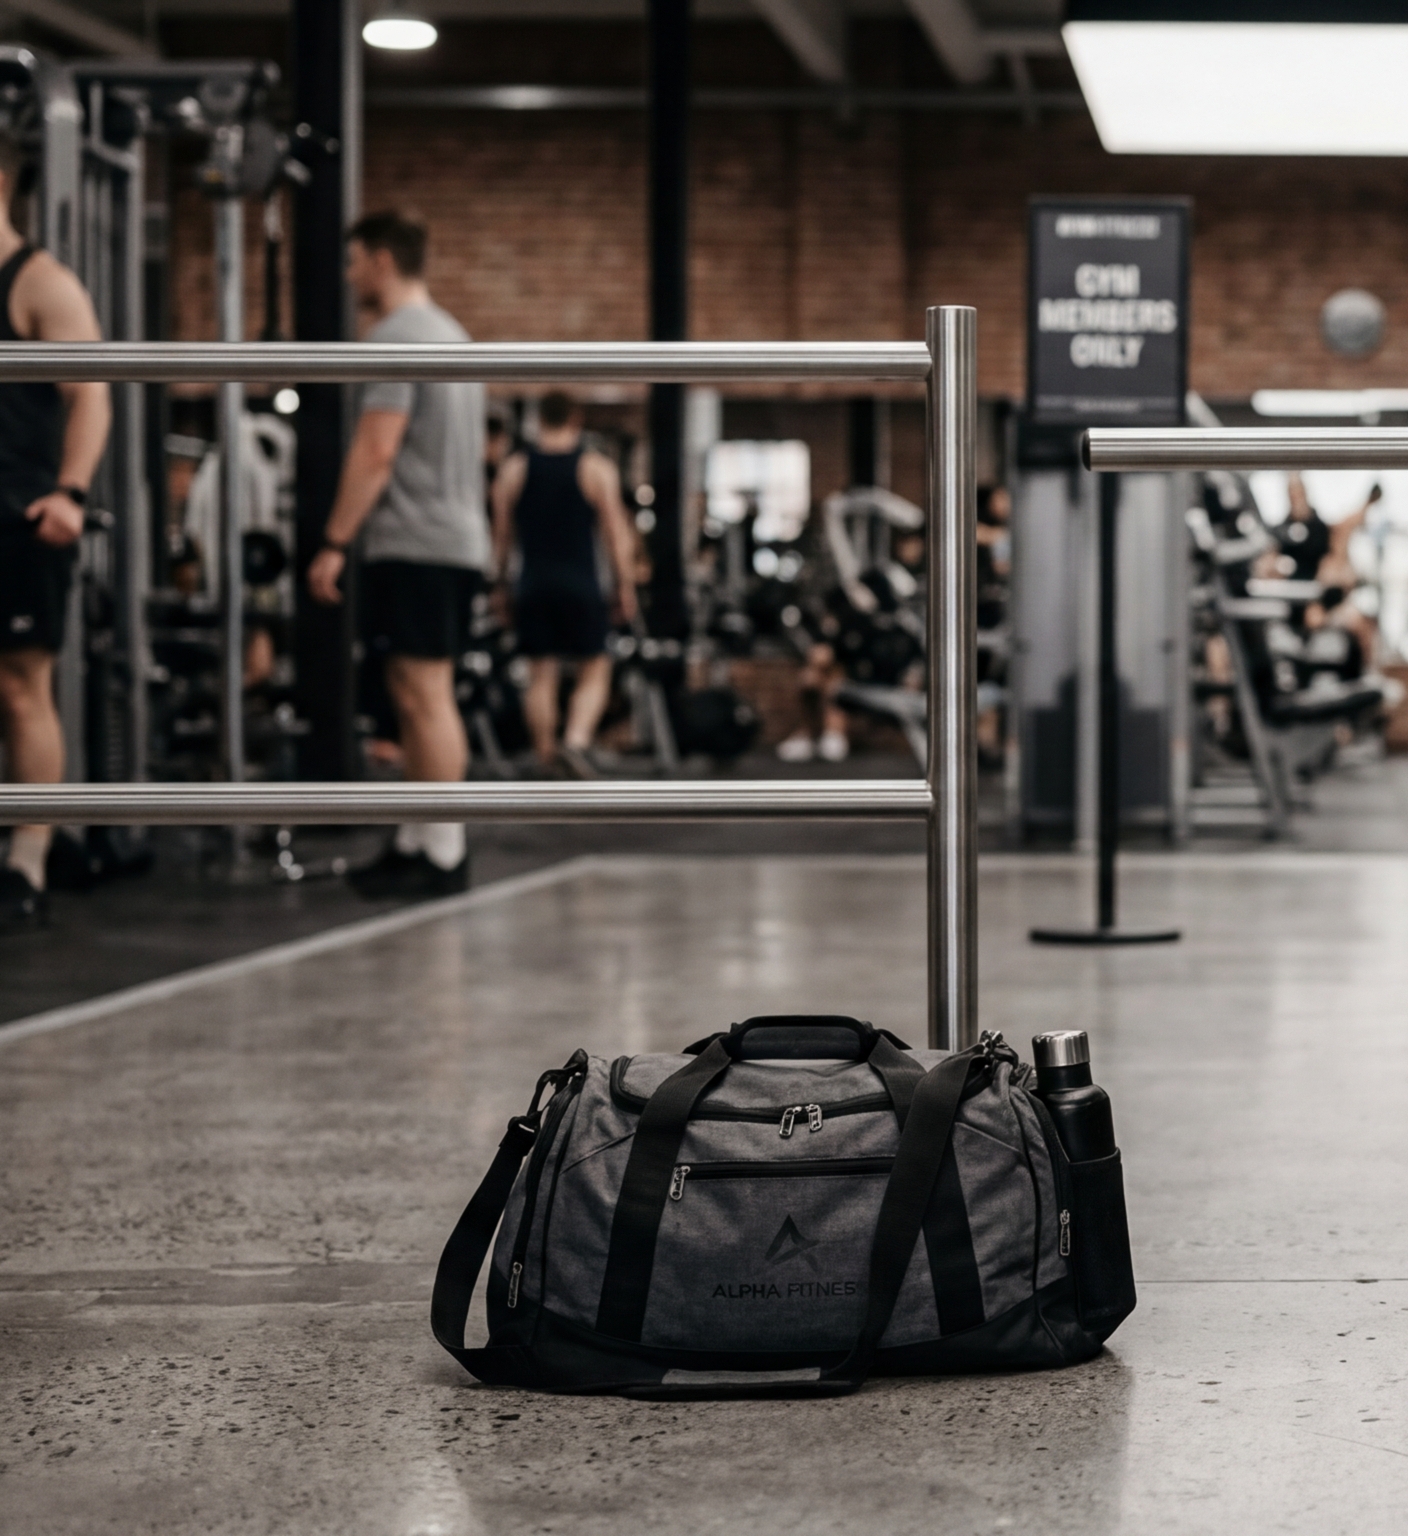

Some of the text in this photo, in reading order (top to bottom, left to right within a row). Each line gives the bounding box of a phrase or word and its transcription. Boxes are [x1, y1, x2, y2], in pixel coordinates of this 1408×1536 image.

[1075, 262, 1140, 297] GYM
[1038, 298, 1177, 333] MEMBERS
[1070, 334, 1144, 368] ONLY
[712, 1283, 781, 1299] ALPHA
